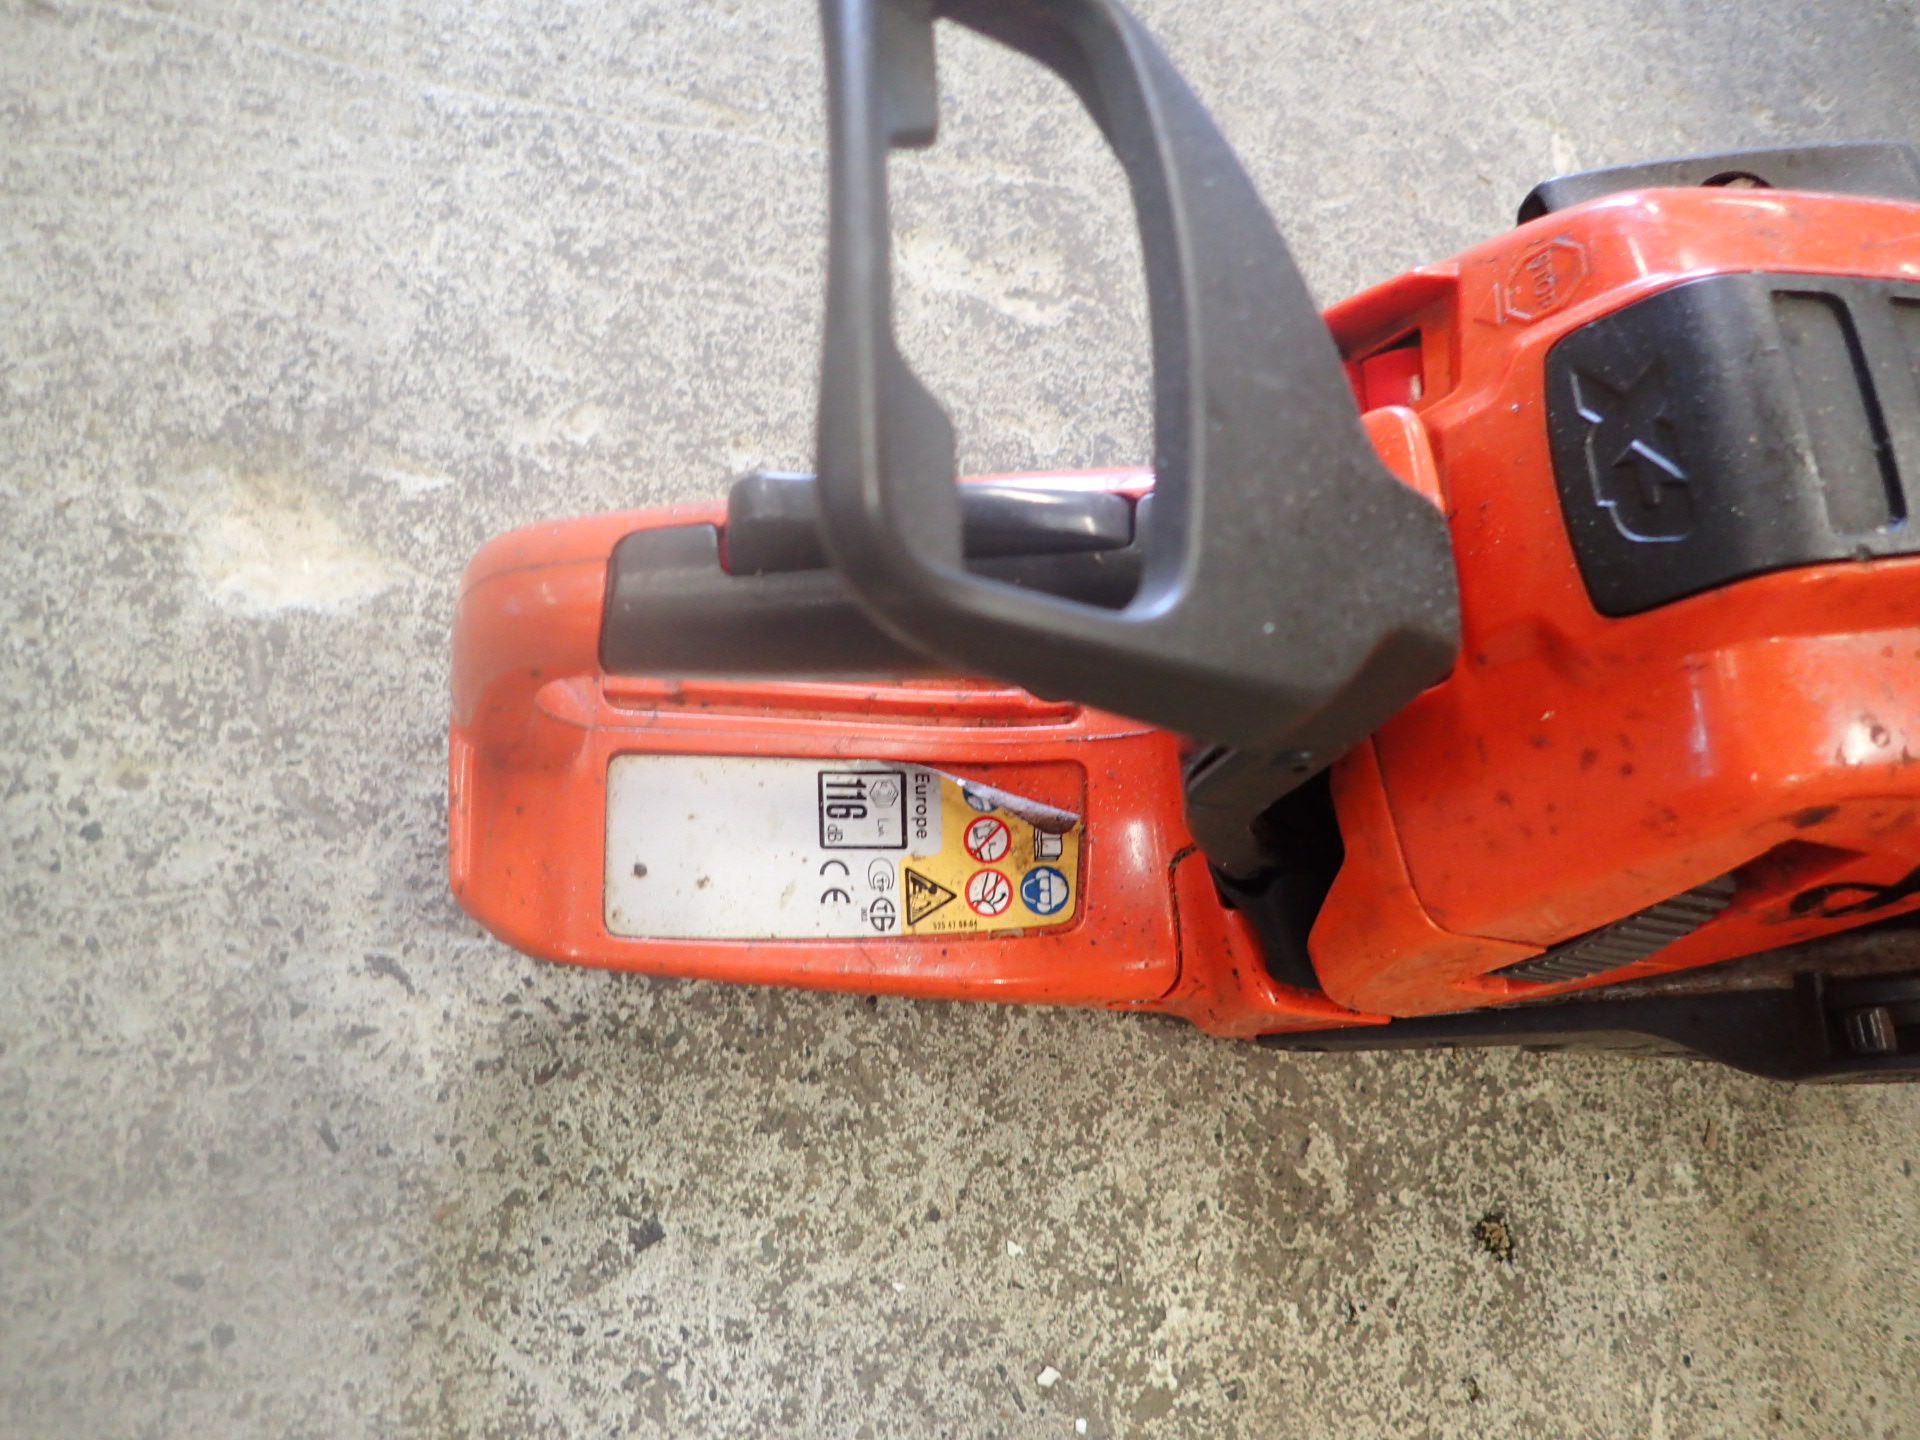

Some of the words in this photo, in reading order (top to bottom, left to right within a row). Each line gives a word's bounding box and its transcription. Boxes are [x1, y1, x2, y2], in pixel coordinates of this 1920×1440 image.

[826, 779, 868, 819] 116
[912, 774, 930, 839] Europe
[827, 824, 843, 842] dB
